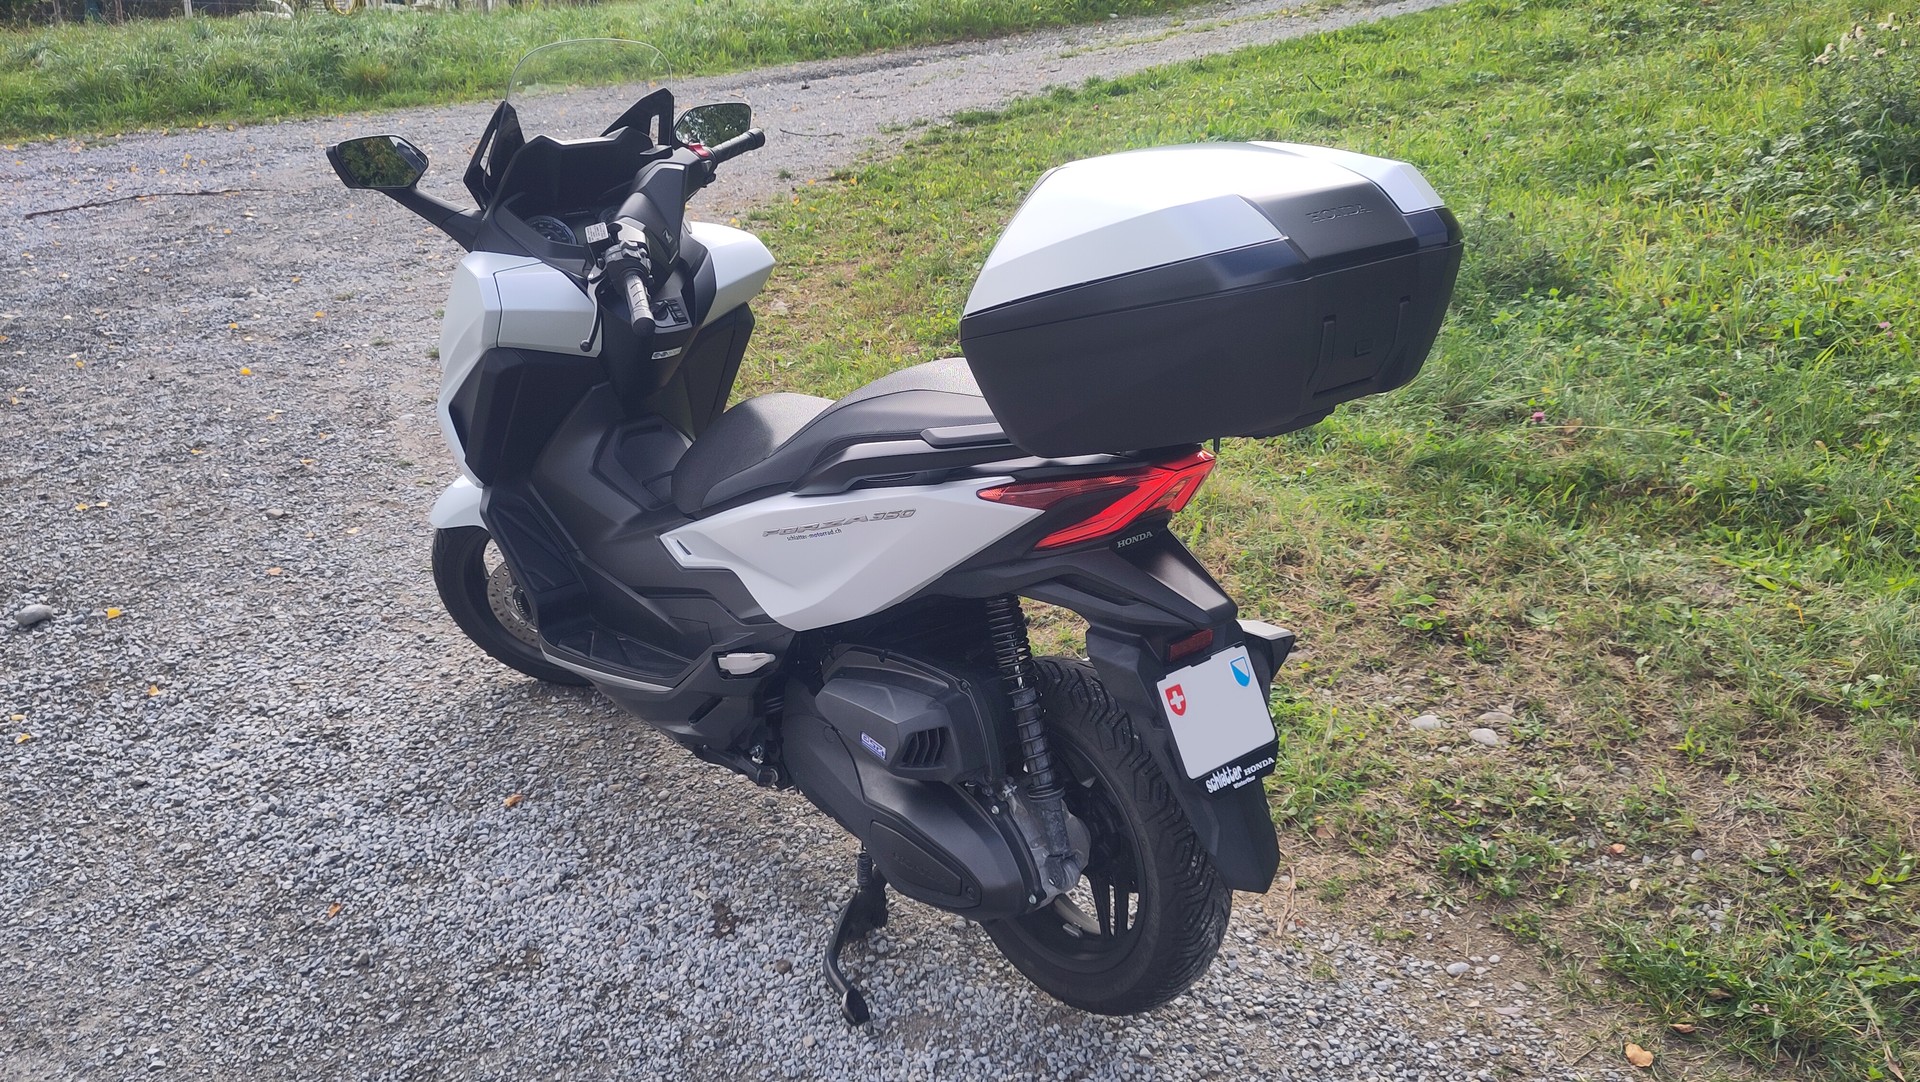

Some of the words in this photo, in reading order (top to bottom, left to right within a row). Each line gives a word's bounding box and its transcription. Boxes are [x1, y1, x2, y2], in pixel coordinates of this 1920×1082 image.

[1306, 203, 1374, 224] HONDA
[1116, 531, 1153, 549] HONDA
[1205, 765, 1242, 793] schlatter
[1243, 757, 1275, 776] HONDA
